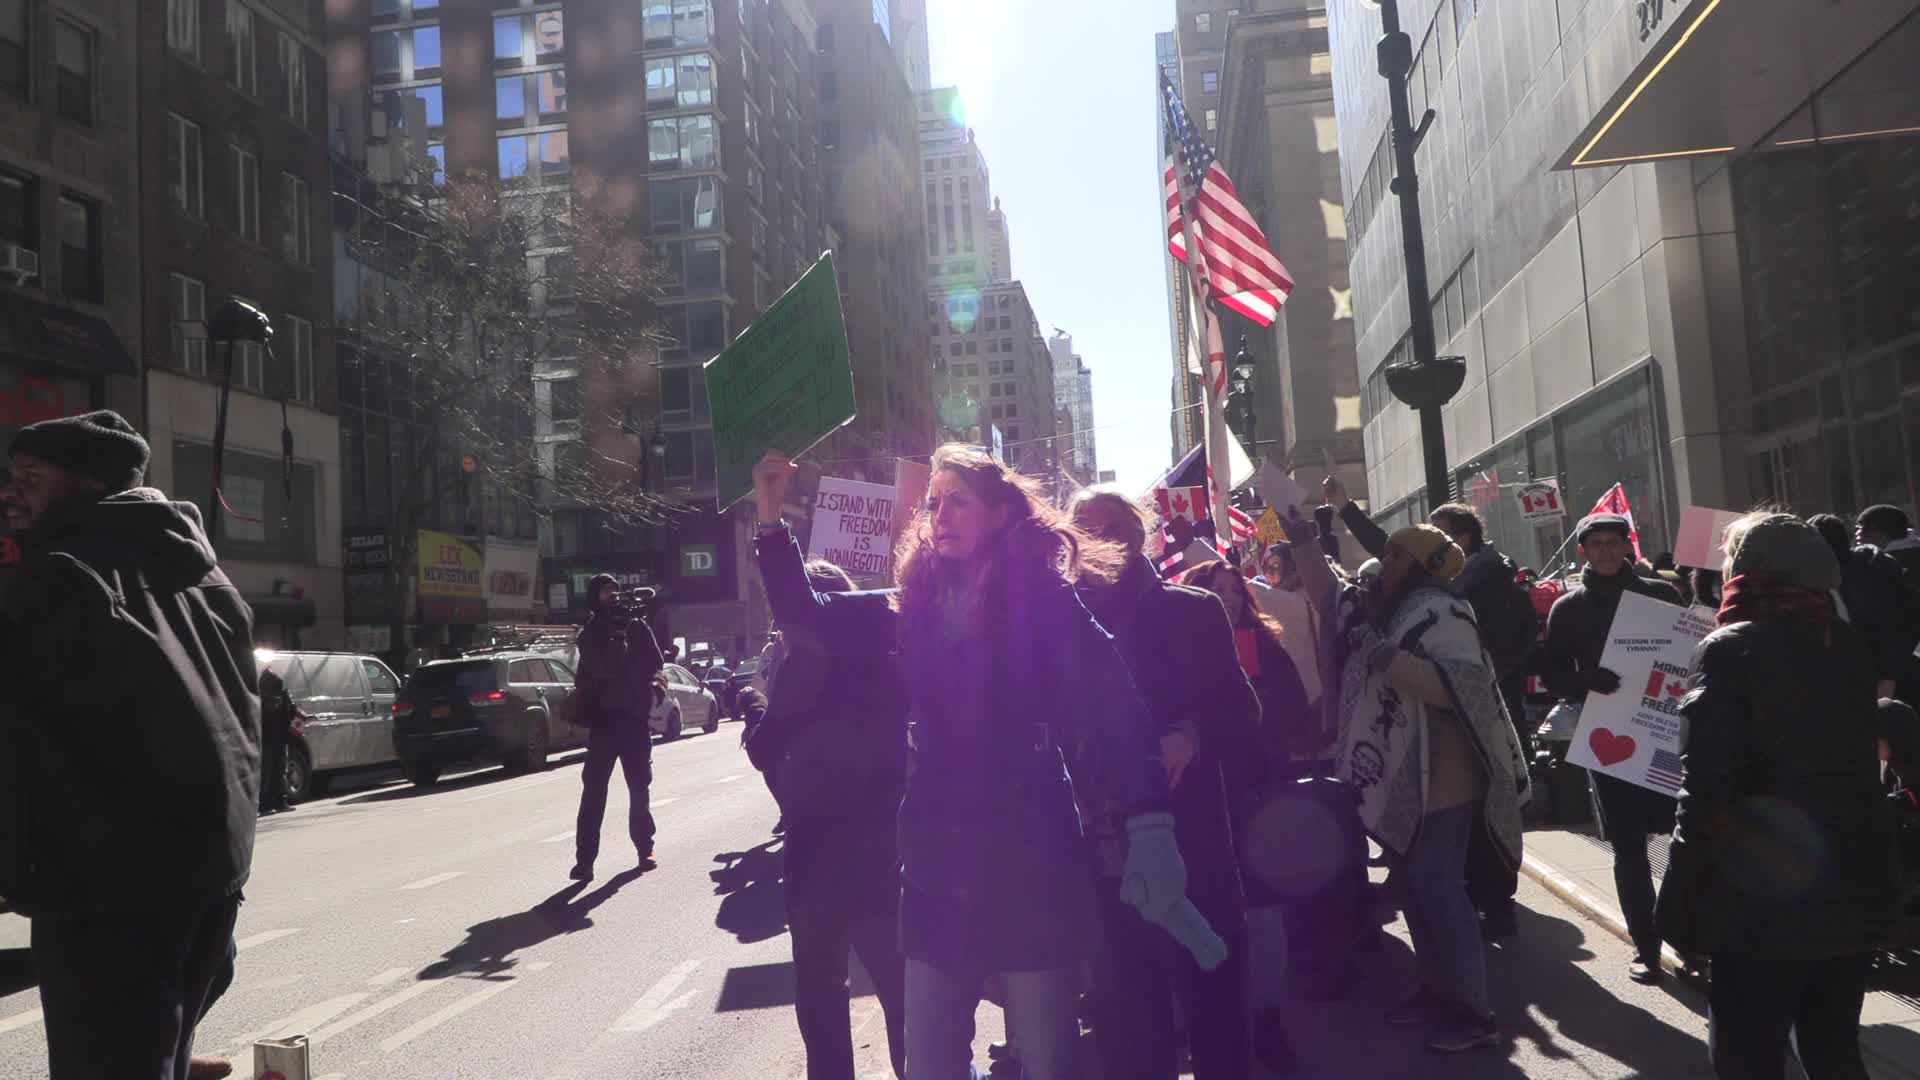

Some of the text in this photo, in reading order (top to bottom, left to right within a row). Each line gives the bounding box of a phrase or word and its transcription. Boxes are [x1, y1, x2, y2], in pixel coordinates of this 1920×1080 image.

[816, 492, 892, 518] I STAND WITH
[839, 514, 892, 537] FREEDOM
[854, 537, 871, 551] IS
[685, 551, 713, 571] TD
[424, 566, 480, 585] NEWSSTAND
[1653, 660, 1688, 678] MAND
